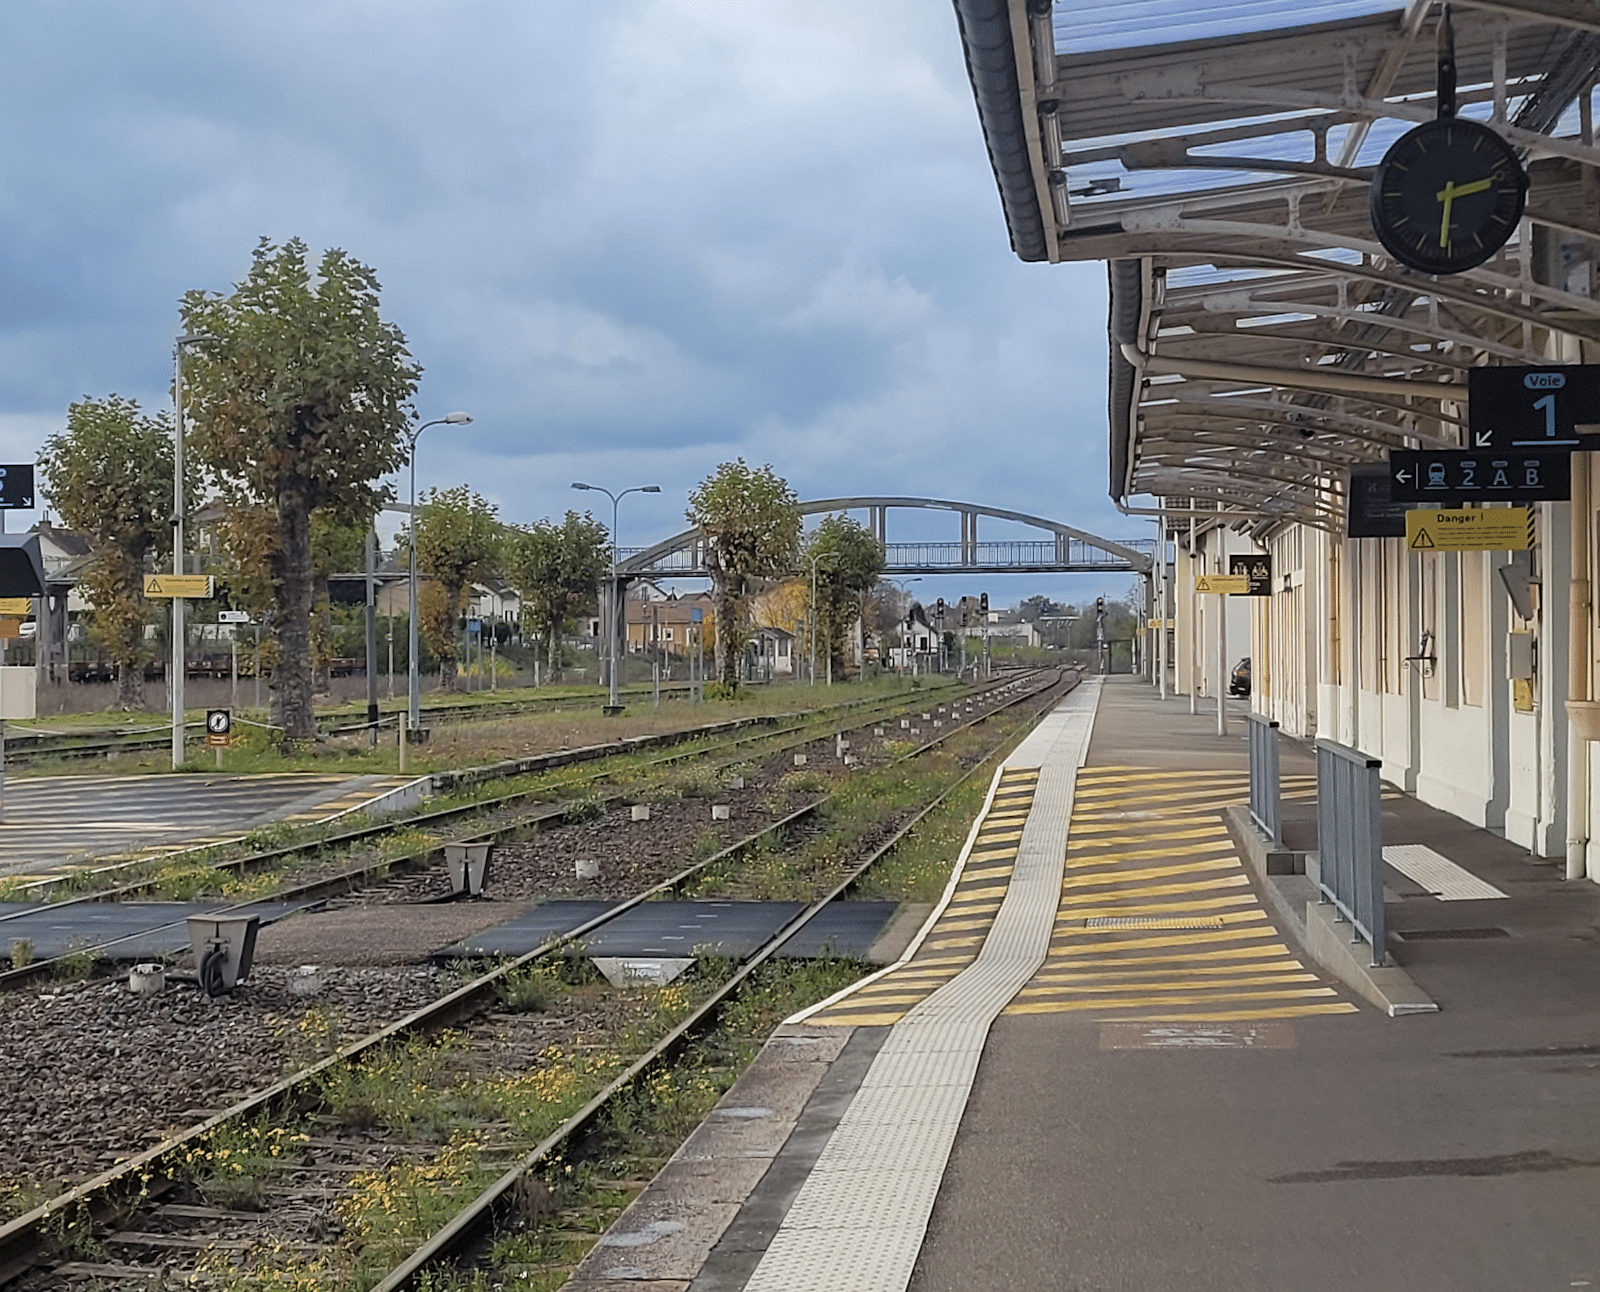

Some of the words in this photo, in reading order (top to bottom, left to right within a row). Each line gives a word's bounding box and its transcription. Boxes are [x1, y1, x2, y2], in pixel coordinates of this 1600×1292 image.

[1529, 375, 1562, 387] Voie
[1532, 394, 1556, 437] 1
[1462, 469, 1475, 486] 2
[1492, 469, 1509, 486] A
[1525, 468, 1540, 486] B
[1436, 513, 1477, 524] Danger
